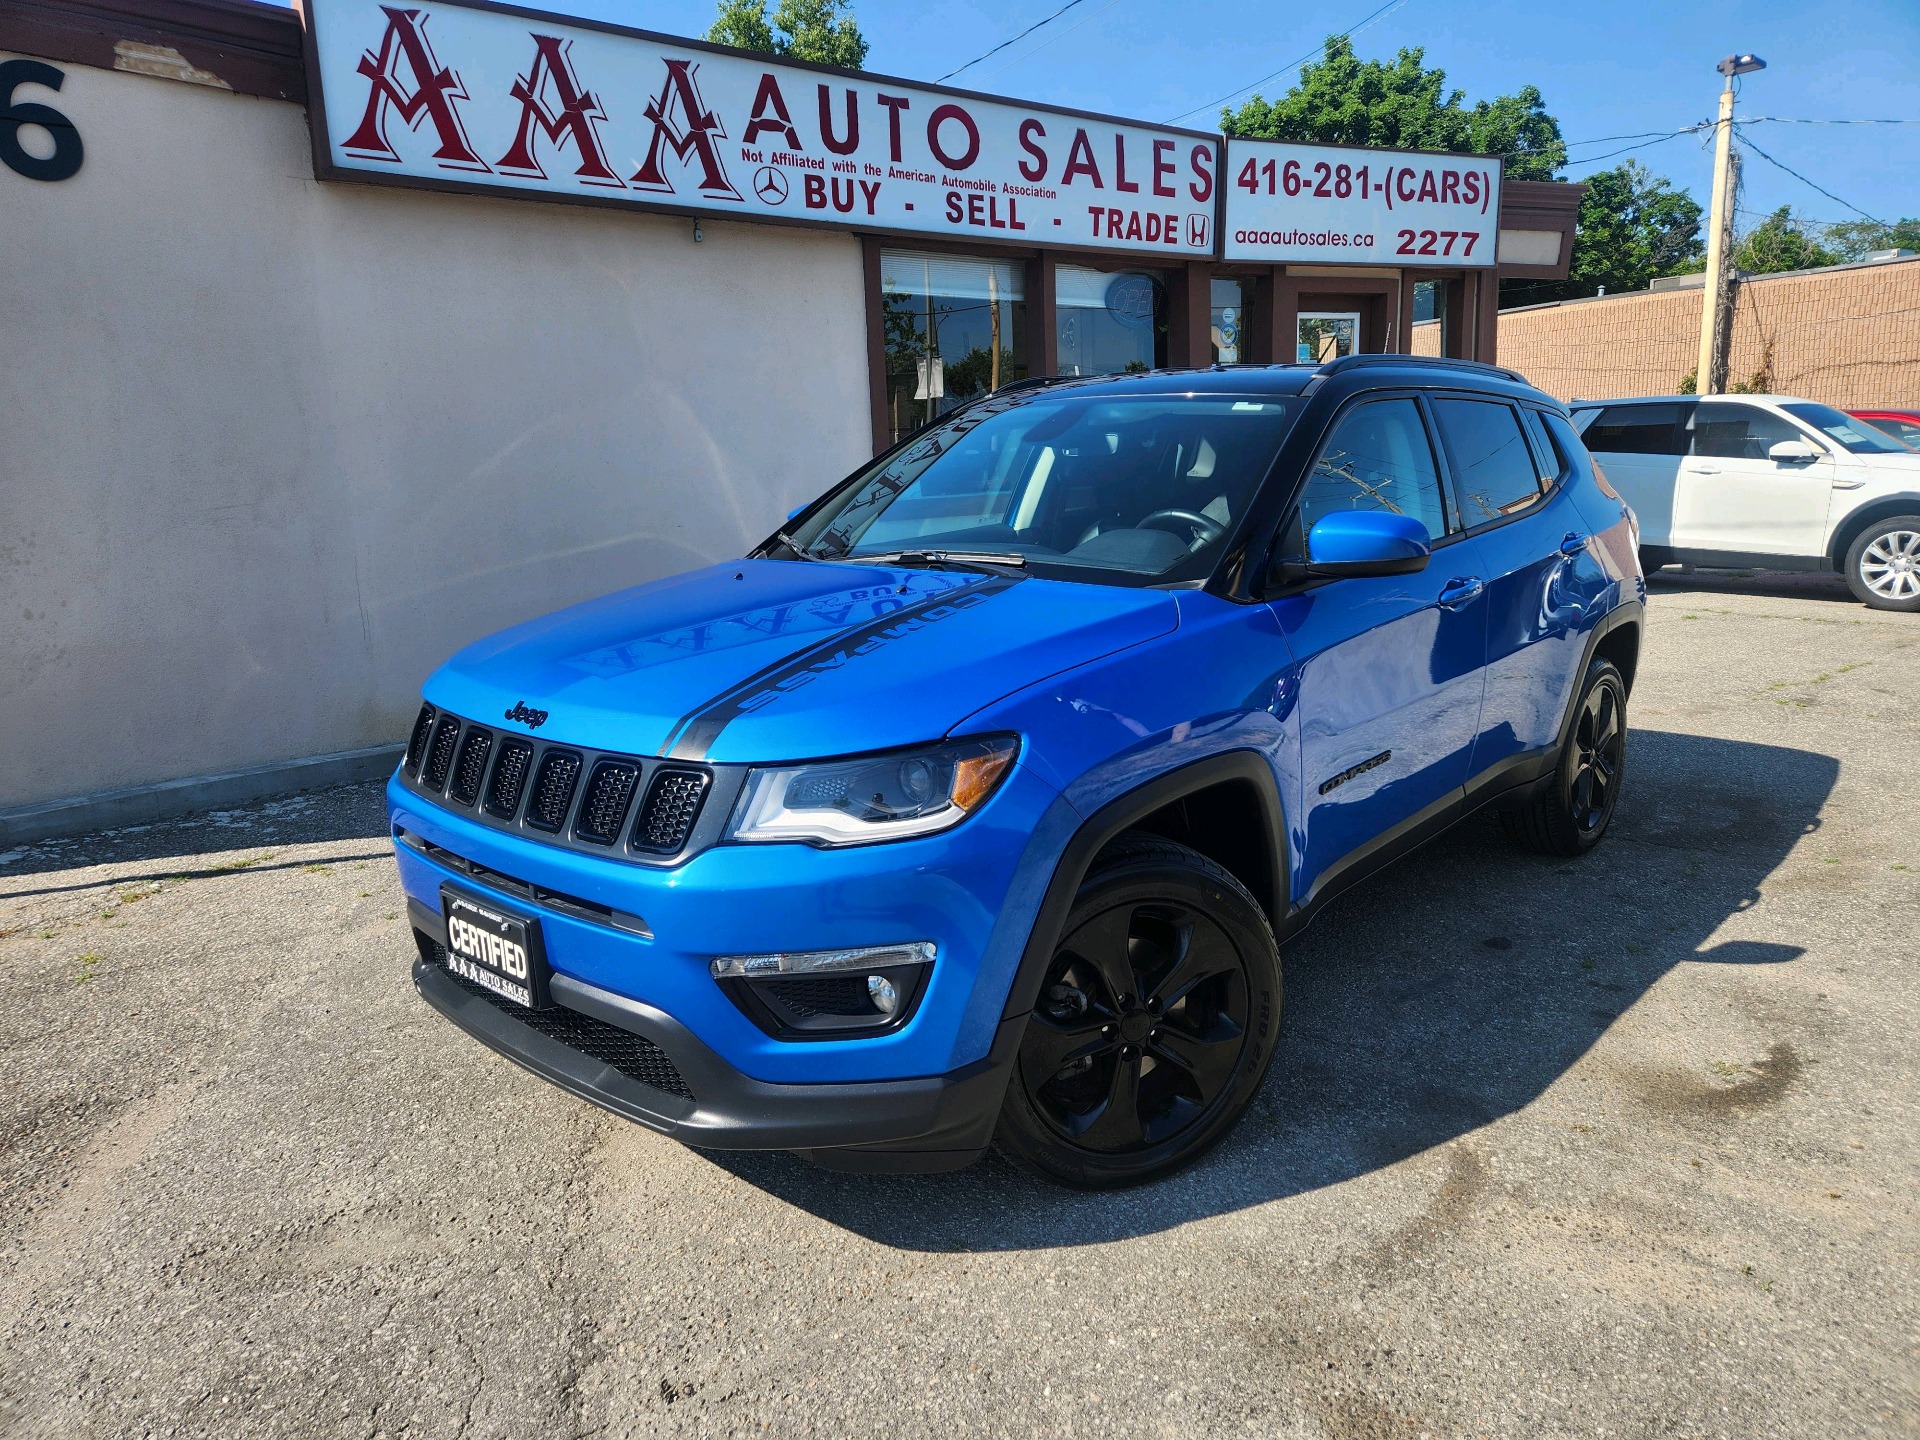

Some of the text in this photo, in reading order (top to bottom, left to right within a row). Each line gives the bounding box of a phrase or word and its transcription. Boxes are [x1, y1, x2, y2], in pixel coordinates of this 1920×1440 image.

[0, 59, 84, 182] 6
[743, 73, 980, 171] AUTO
[1018, 118, 1213, 203] SALES
[742, 148, 1057, 199] Not Affiliated with the American Automobile Association
[1238, 157, 1490, 214] 416-281-(CARS)
[804, 174, 881, 215] BUY
[945, 191, 1026, 230] SELL
[1088, 206, 1179, 244] TRADE
[1235, 229, 1374, 247] aaaautosales.ca
[1396, 229, 1480, 257] 2277
[504, 700, 549, 730] Jeep
[449, 915, 527, 980] CERTIFIED
[480, 969, 501, 988] AUTO
[502, 980, 531, 1002] SALES
